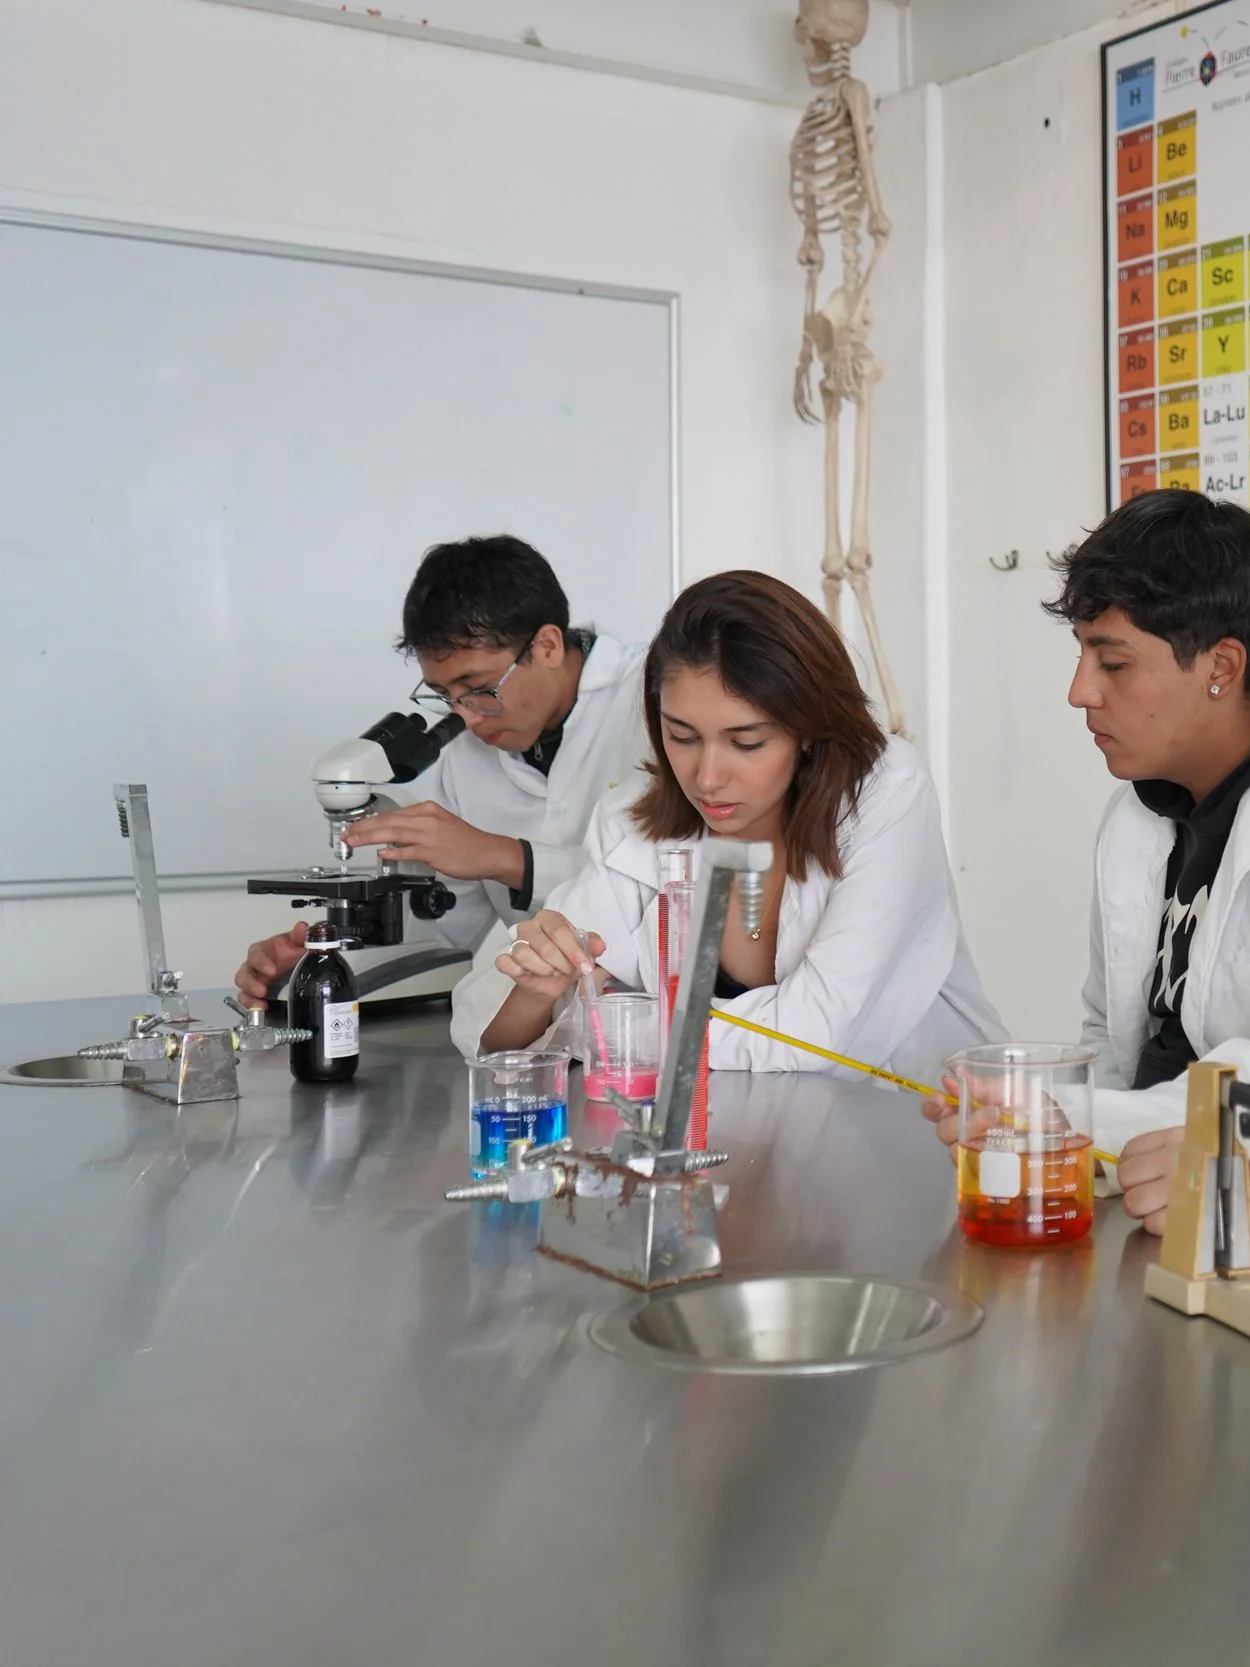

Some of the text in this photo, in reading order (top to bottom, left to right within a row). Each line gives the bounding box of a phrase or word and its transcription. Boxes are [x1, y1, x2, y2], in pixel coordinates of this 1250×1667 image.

[1129, 88, 1141, 106] H
[1167, 143, 1187, 162] Be
[1165, 210, 1188, 229] Mg
[1169, 413, 1189, 430] Ba
[1064, 1211, 1076, 1219] 100
